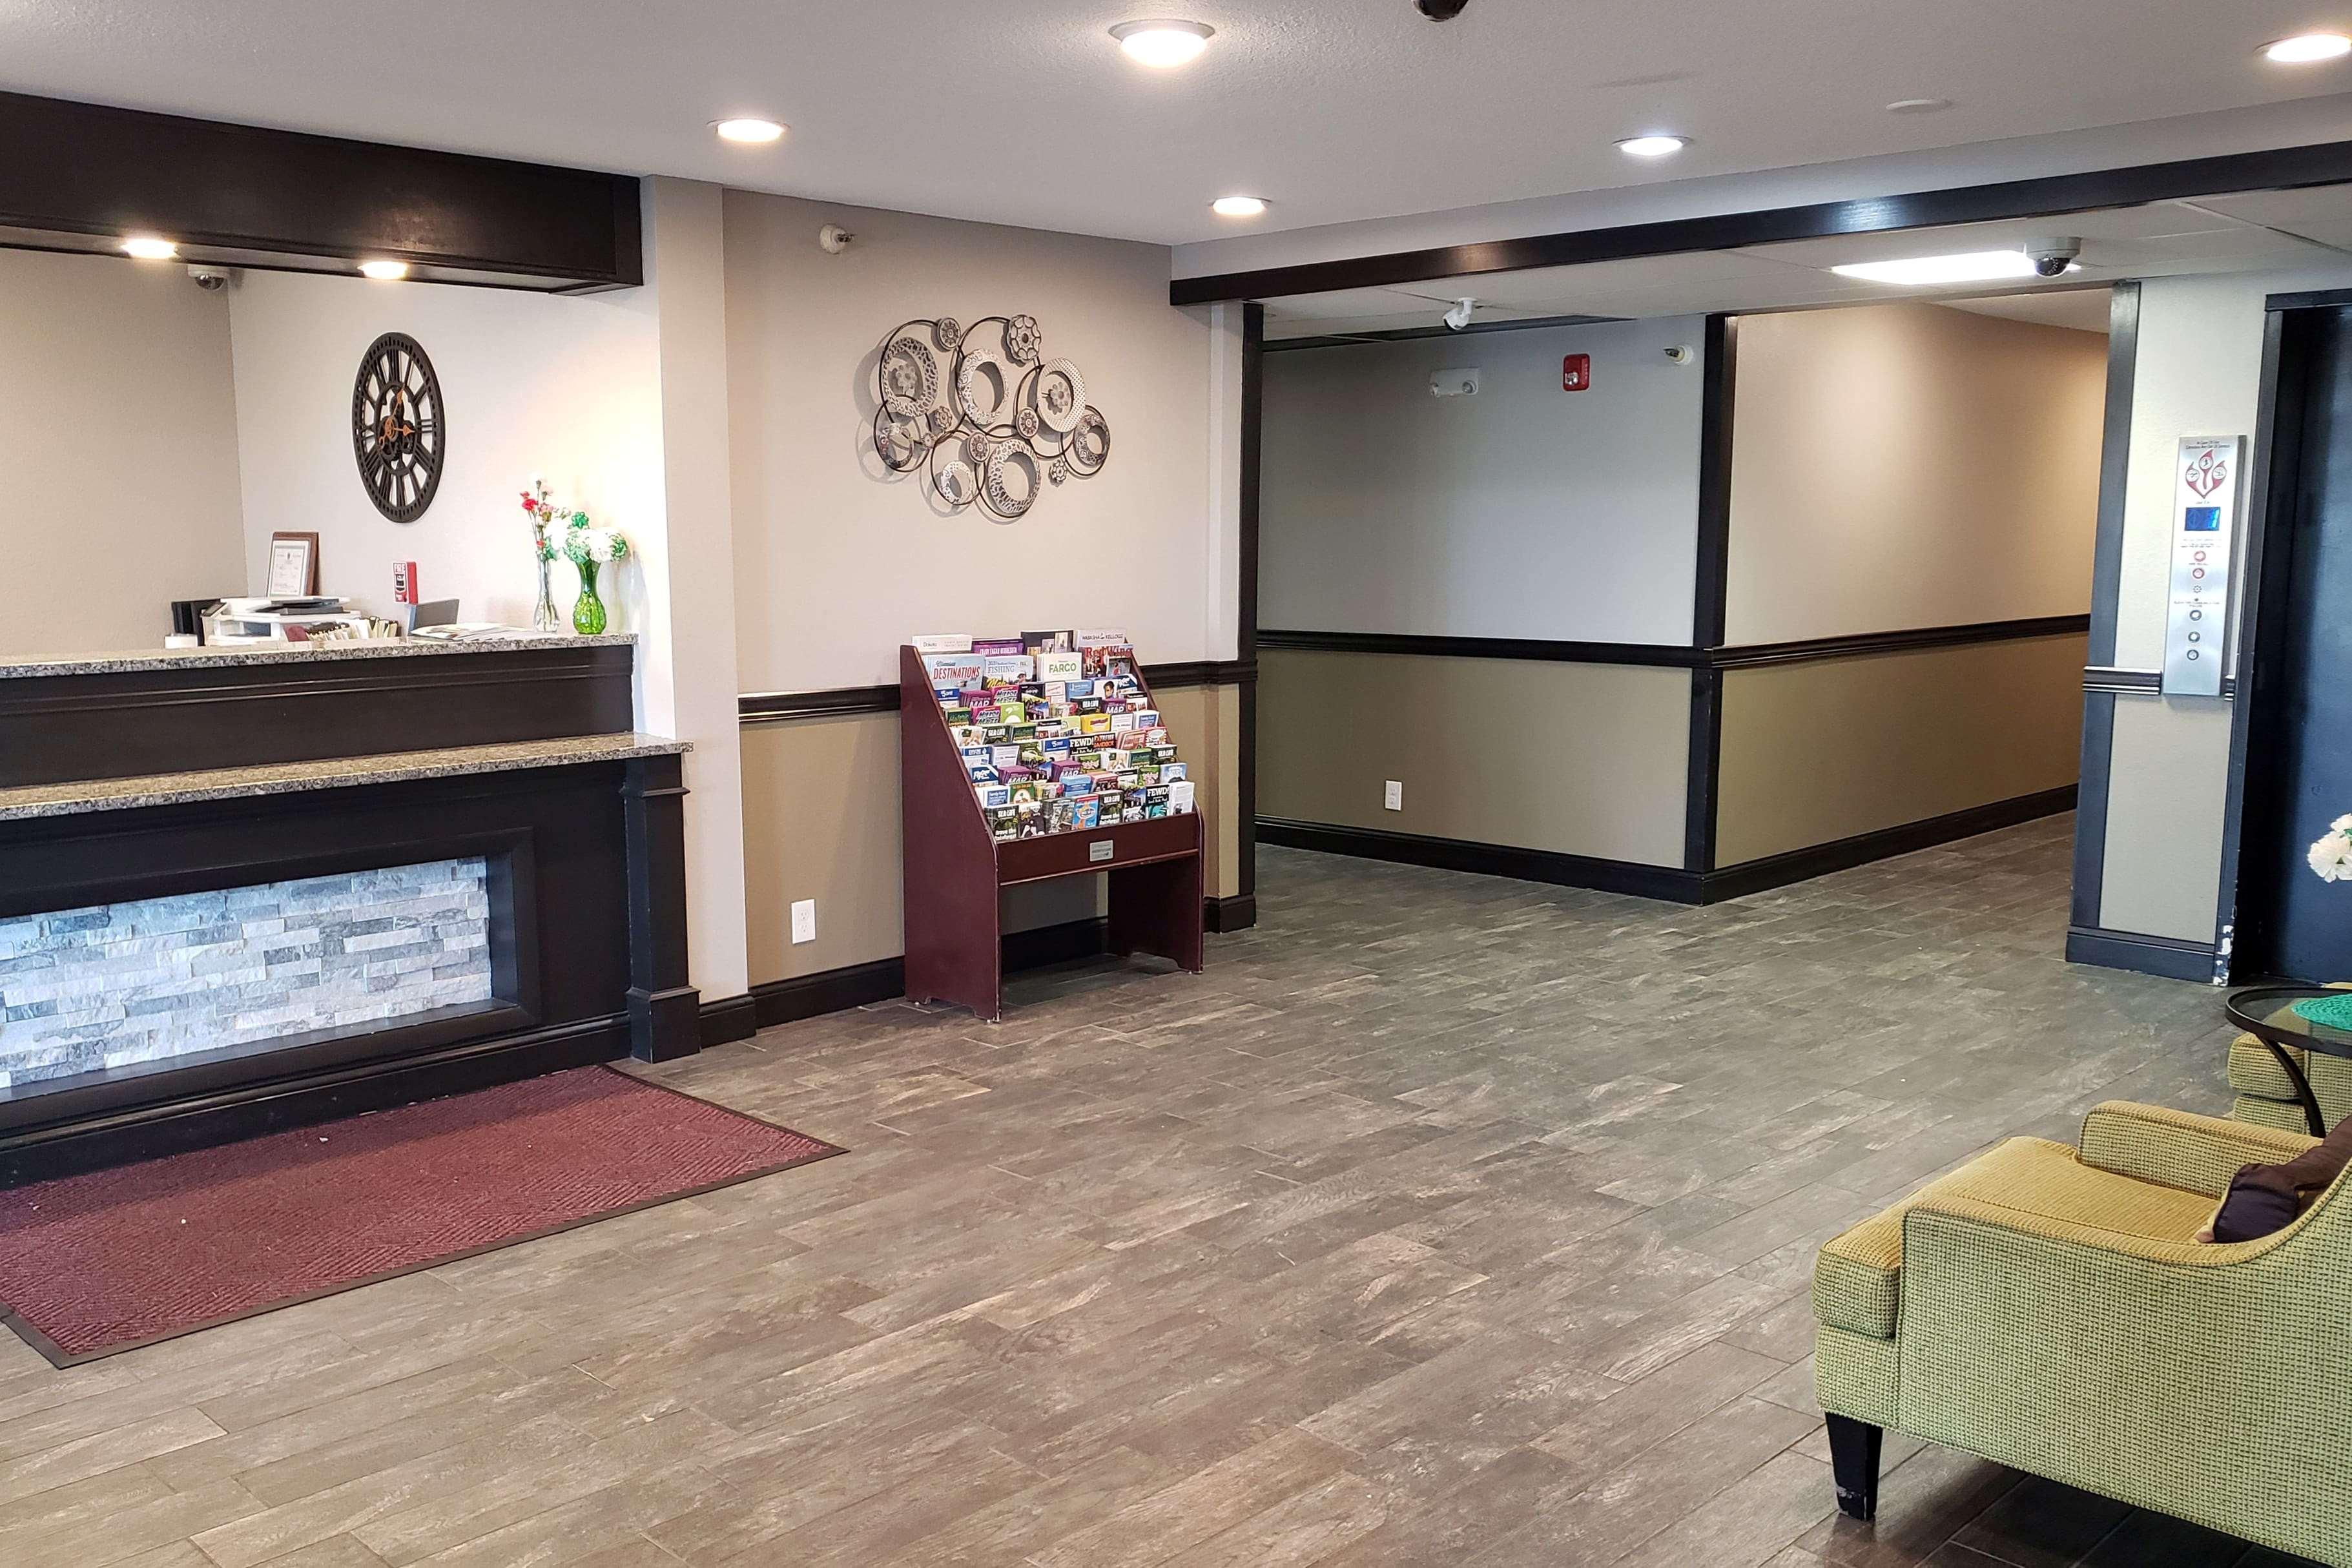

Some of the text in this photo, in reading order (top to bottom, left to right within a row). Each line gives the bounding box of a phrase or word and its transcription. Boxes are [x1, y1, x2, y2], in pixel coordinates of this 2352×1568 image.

[394, 563, 406, 573] FIRE
[1084, 645, 1133, 657] Red Wing
[934, 666, 980, 679] DESTINATIONS
[988, 665, 1015, 674] FISHING
[1049, 663, 1077, 673] FARGO
[1069, 738, 1094, 747] FEWD!
[1147, 787, 1170, 797] FEWD!
